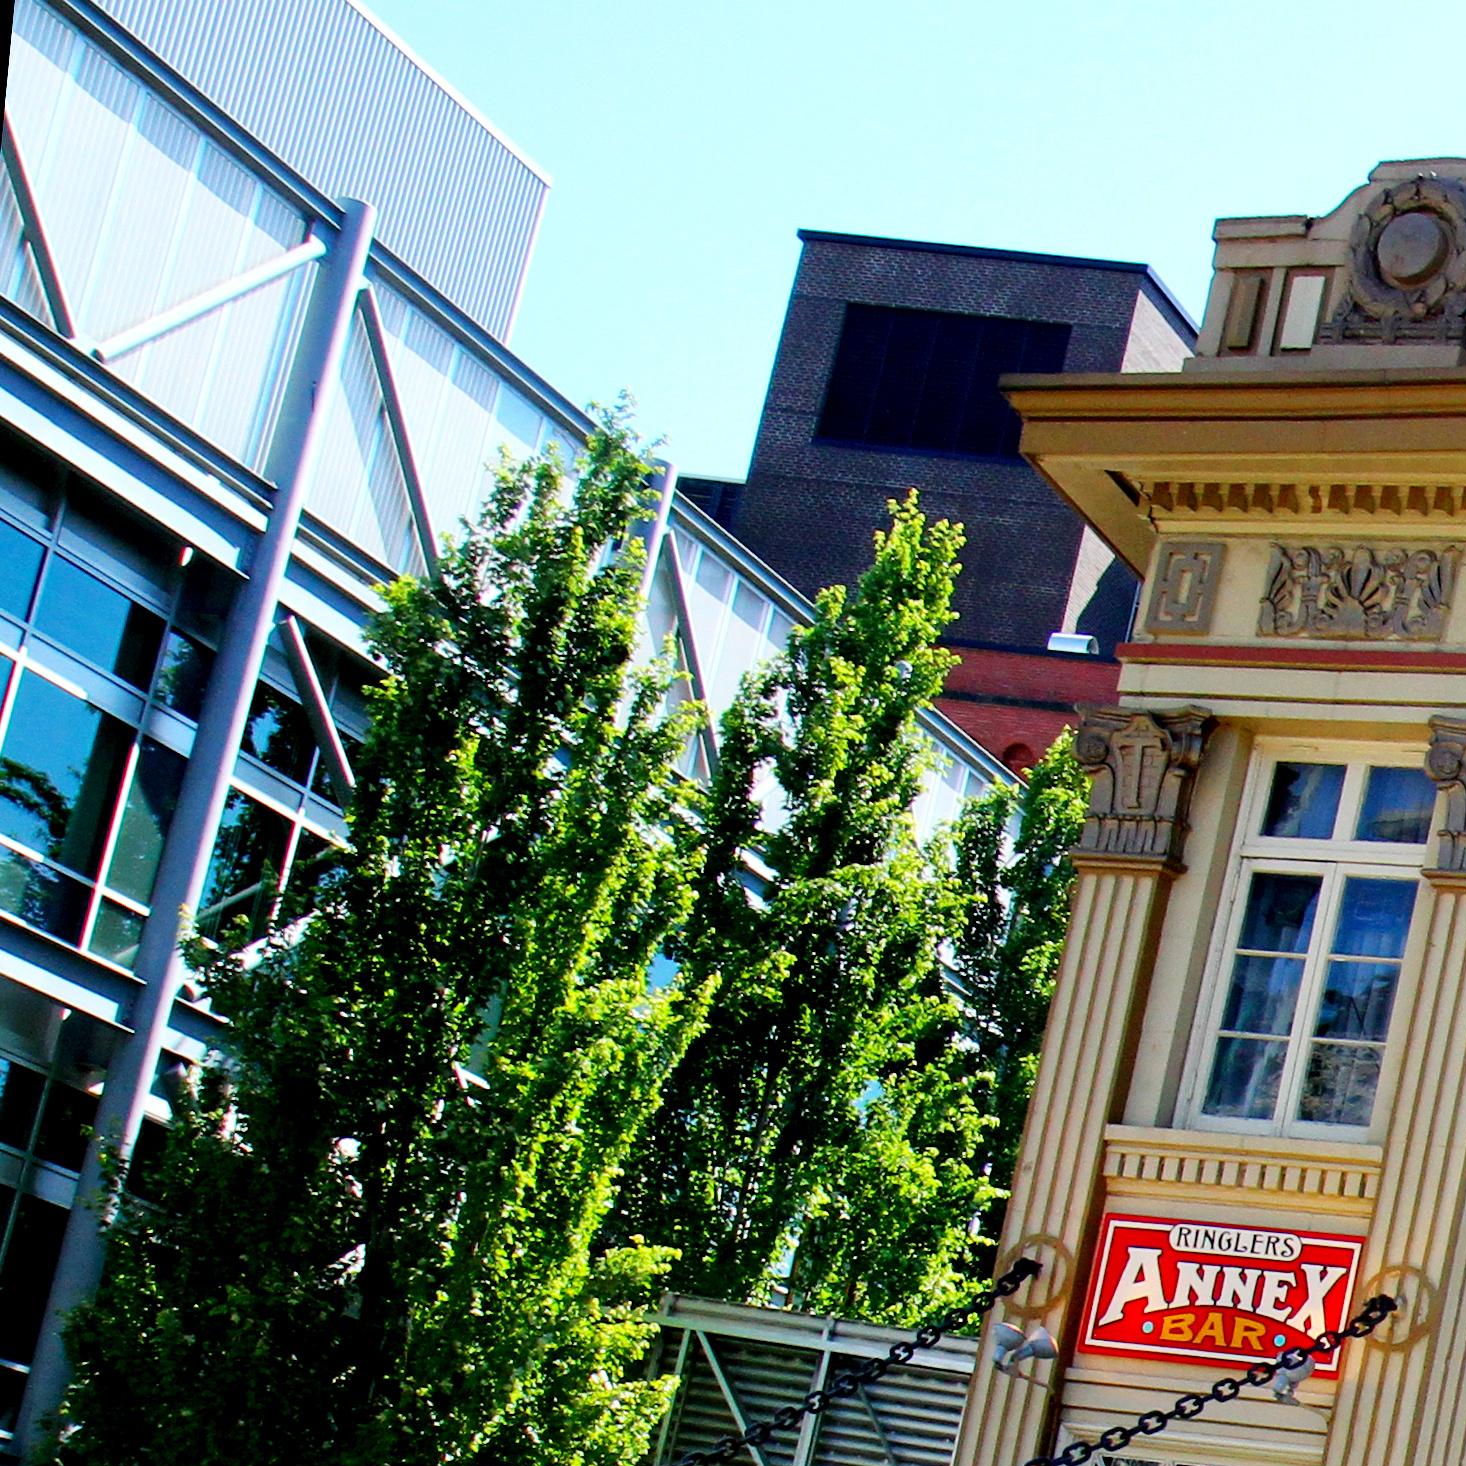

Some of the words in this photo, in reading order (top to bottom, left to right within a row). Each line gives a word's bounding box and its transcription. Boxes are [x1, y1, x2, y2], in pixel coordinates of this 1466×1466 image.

[1176, 1226, 1296, 1259] RINGLERS
[1098, 1246, 1347, 1344] ANNEX
[1160, 1312, 1267, 1351] BAR
